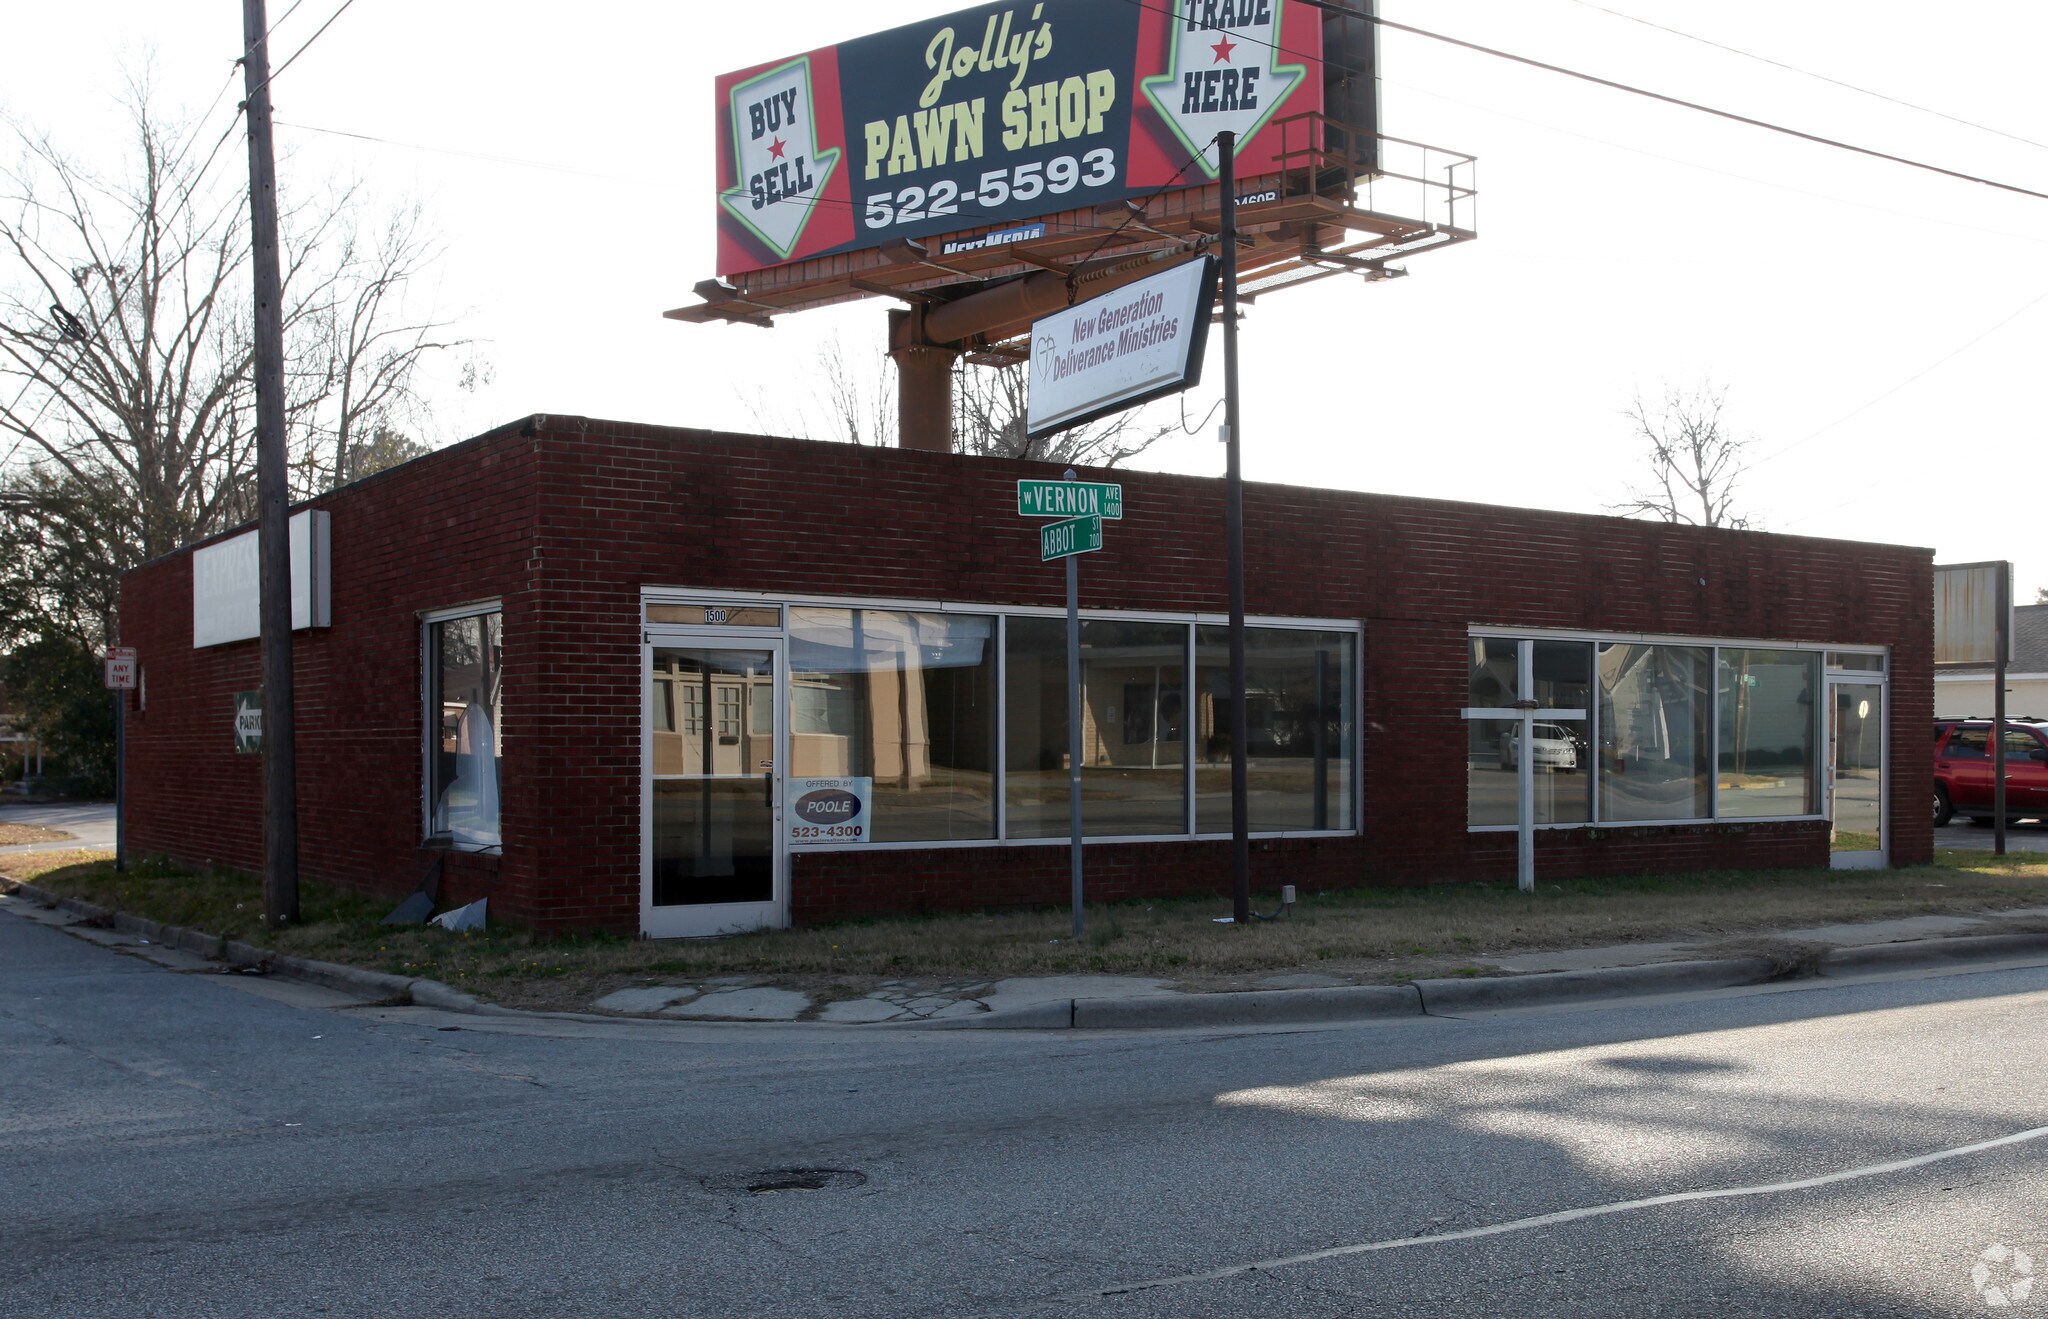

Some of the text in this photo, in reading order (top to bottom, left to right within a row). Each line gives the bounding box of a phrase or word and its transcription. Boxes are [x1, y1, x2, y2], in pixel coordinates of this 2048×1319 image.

[1185, 0, 1271, 32] TRADE
[919, 3, 1053, 108] Jolly's
[1181, 67, 1260, 114] HERE
[748, 87, 798, 140] BUY
[864, 69, 1116, 180] PAWN SHOP
[749, 155, 813, 211] SELL
[864, 148, 1116, 229] 522-5593
[1072, 290, 1164, 345] New Generation
[1053, 315, 1179, 382] Deliverance Ministries
[1023, 486, 1119, 513] W VERNON AVE
[1103, 502, 1120, 516] 1400
[1043, 517, 1099, 556] ABBOT ST
[1089, 533, 1099, 547] 700
[705, 609, 727, 622] 1500
[112, 674, 130, 683] TIME
[113, 664, 129, 673] ANY
[239, 714, 262, 730] PARK
[806, 780, 839, 788] OFFERED
[806, 800, 851, 813] POOLE
[791, 825, 863, 838] 523-4300
